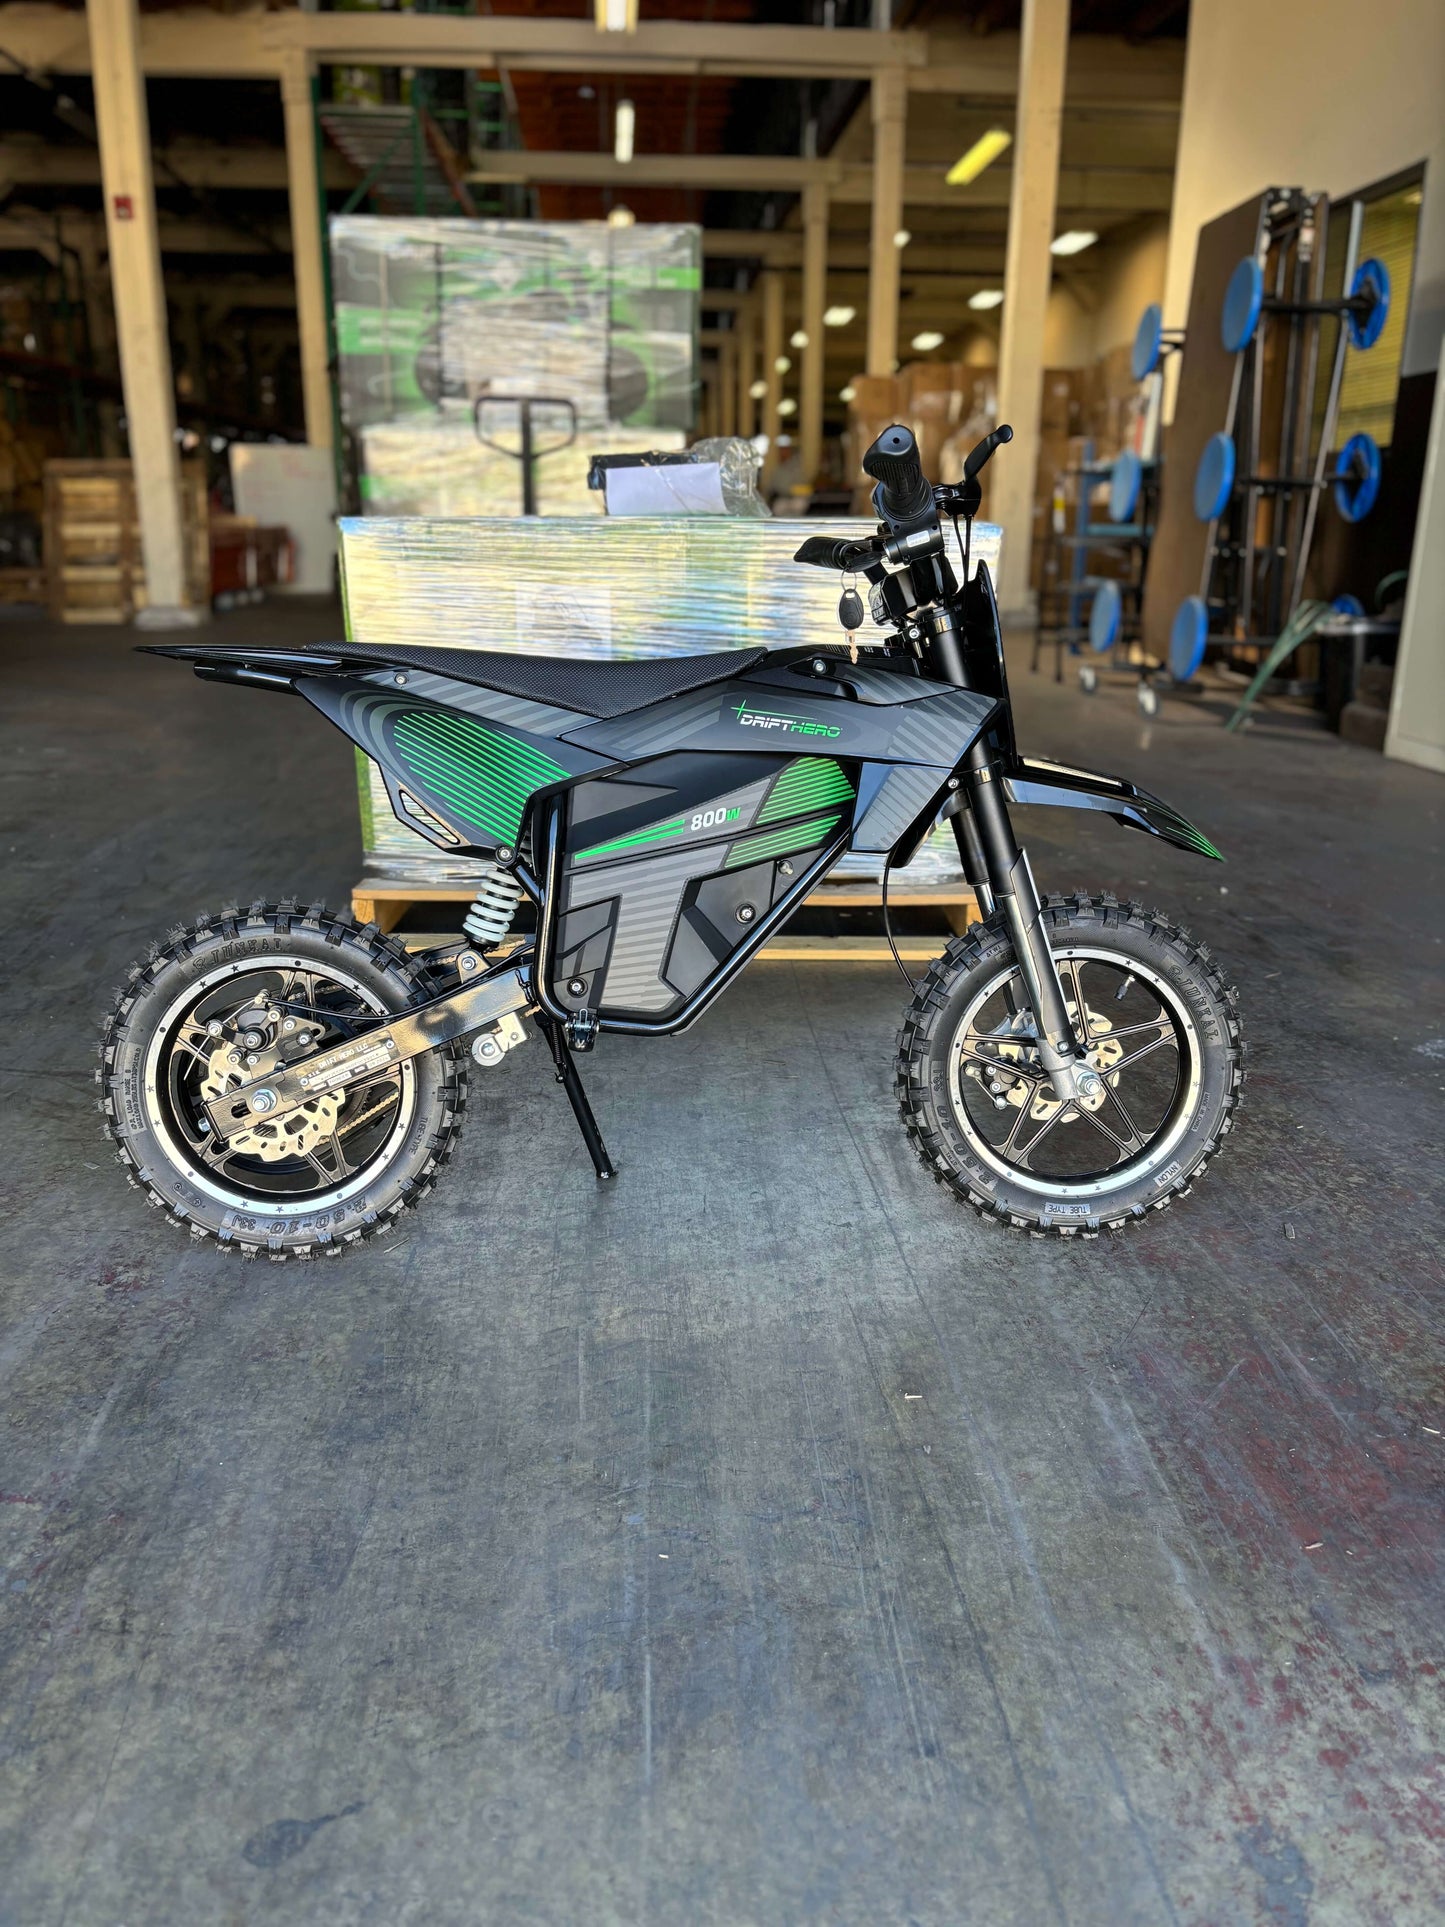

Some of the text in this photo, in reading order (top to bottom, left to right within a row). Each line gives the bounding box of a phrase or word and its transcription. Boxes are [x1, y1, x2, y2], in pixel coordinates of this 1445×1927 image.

[690, 807, 741, 831] 800W
[1157, 1164, 1178, 1183] NYLON
[1048, 1204, 1065, 1213] TYPE
